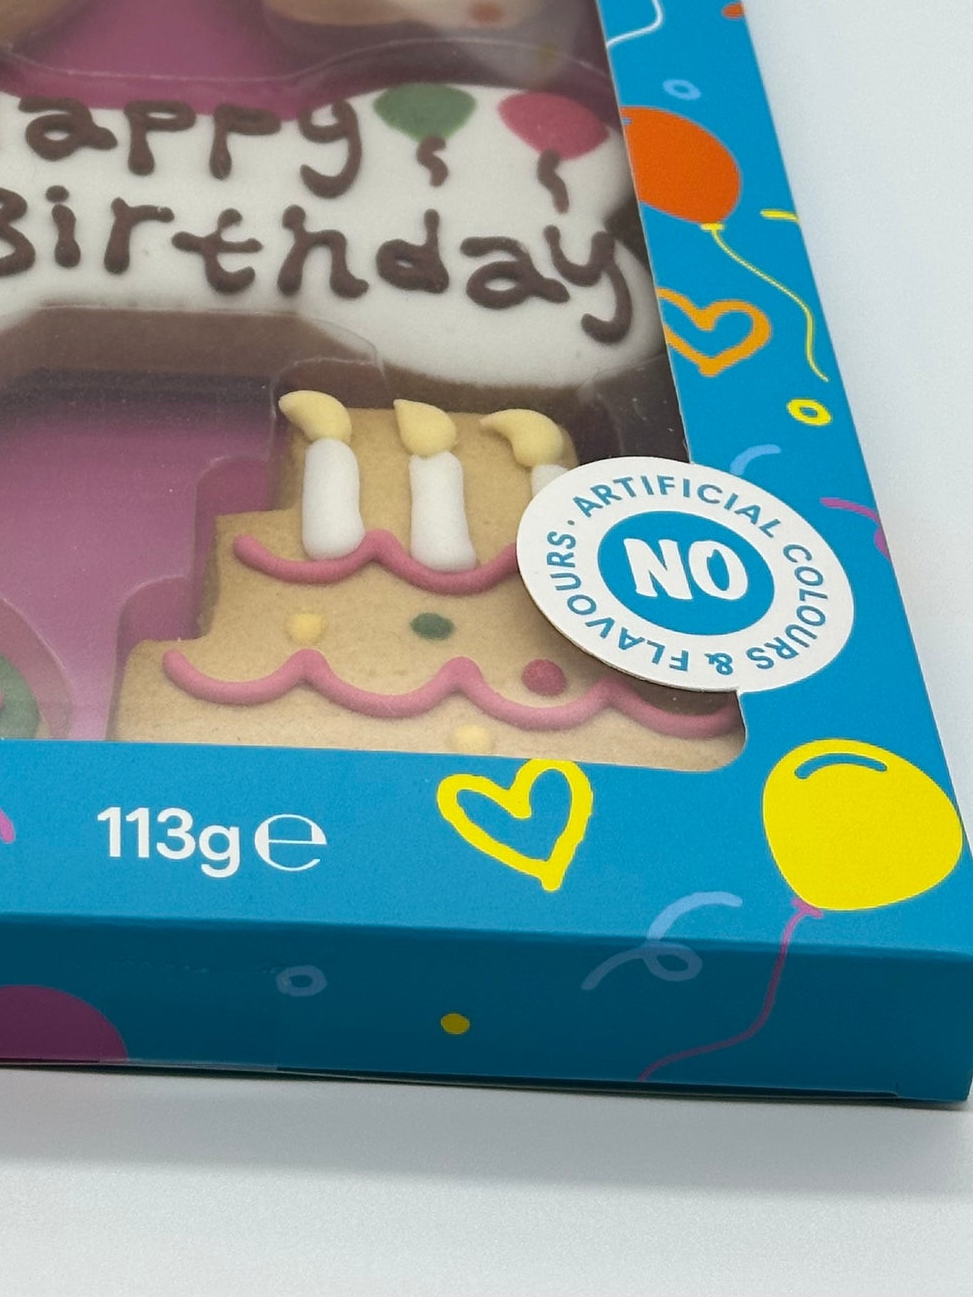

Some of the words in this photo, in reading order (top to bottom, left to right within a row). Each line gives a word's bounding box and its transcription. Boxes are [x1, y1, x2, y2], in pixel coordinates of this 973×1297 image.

[572, 474, 783, 539] ARTIFICIAL
[546, 530, 690, 672] FLAVOURS
[624, 538, 749, 601] NO
[747, 543, 828, 670] COLOURS
[704, 652, 735, 676] &
[96, 806, 241, 879] 113g
